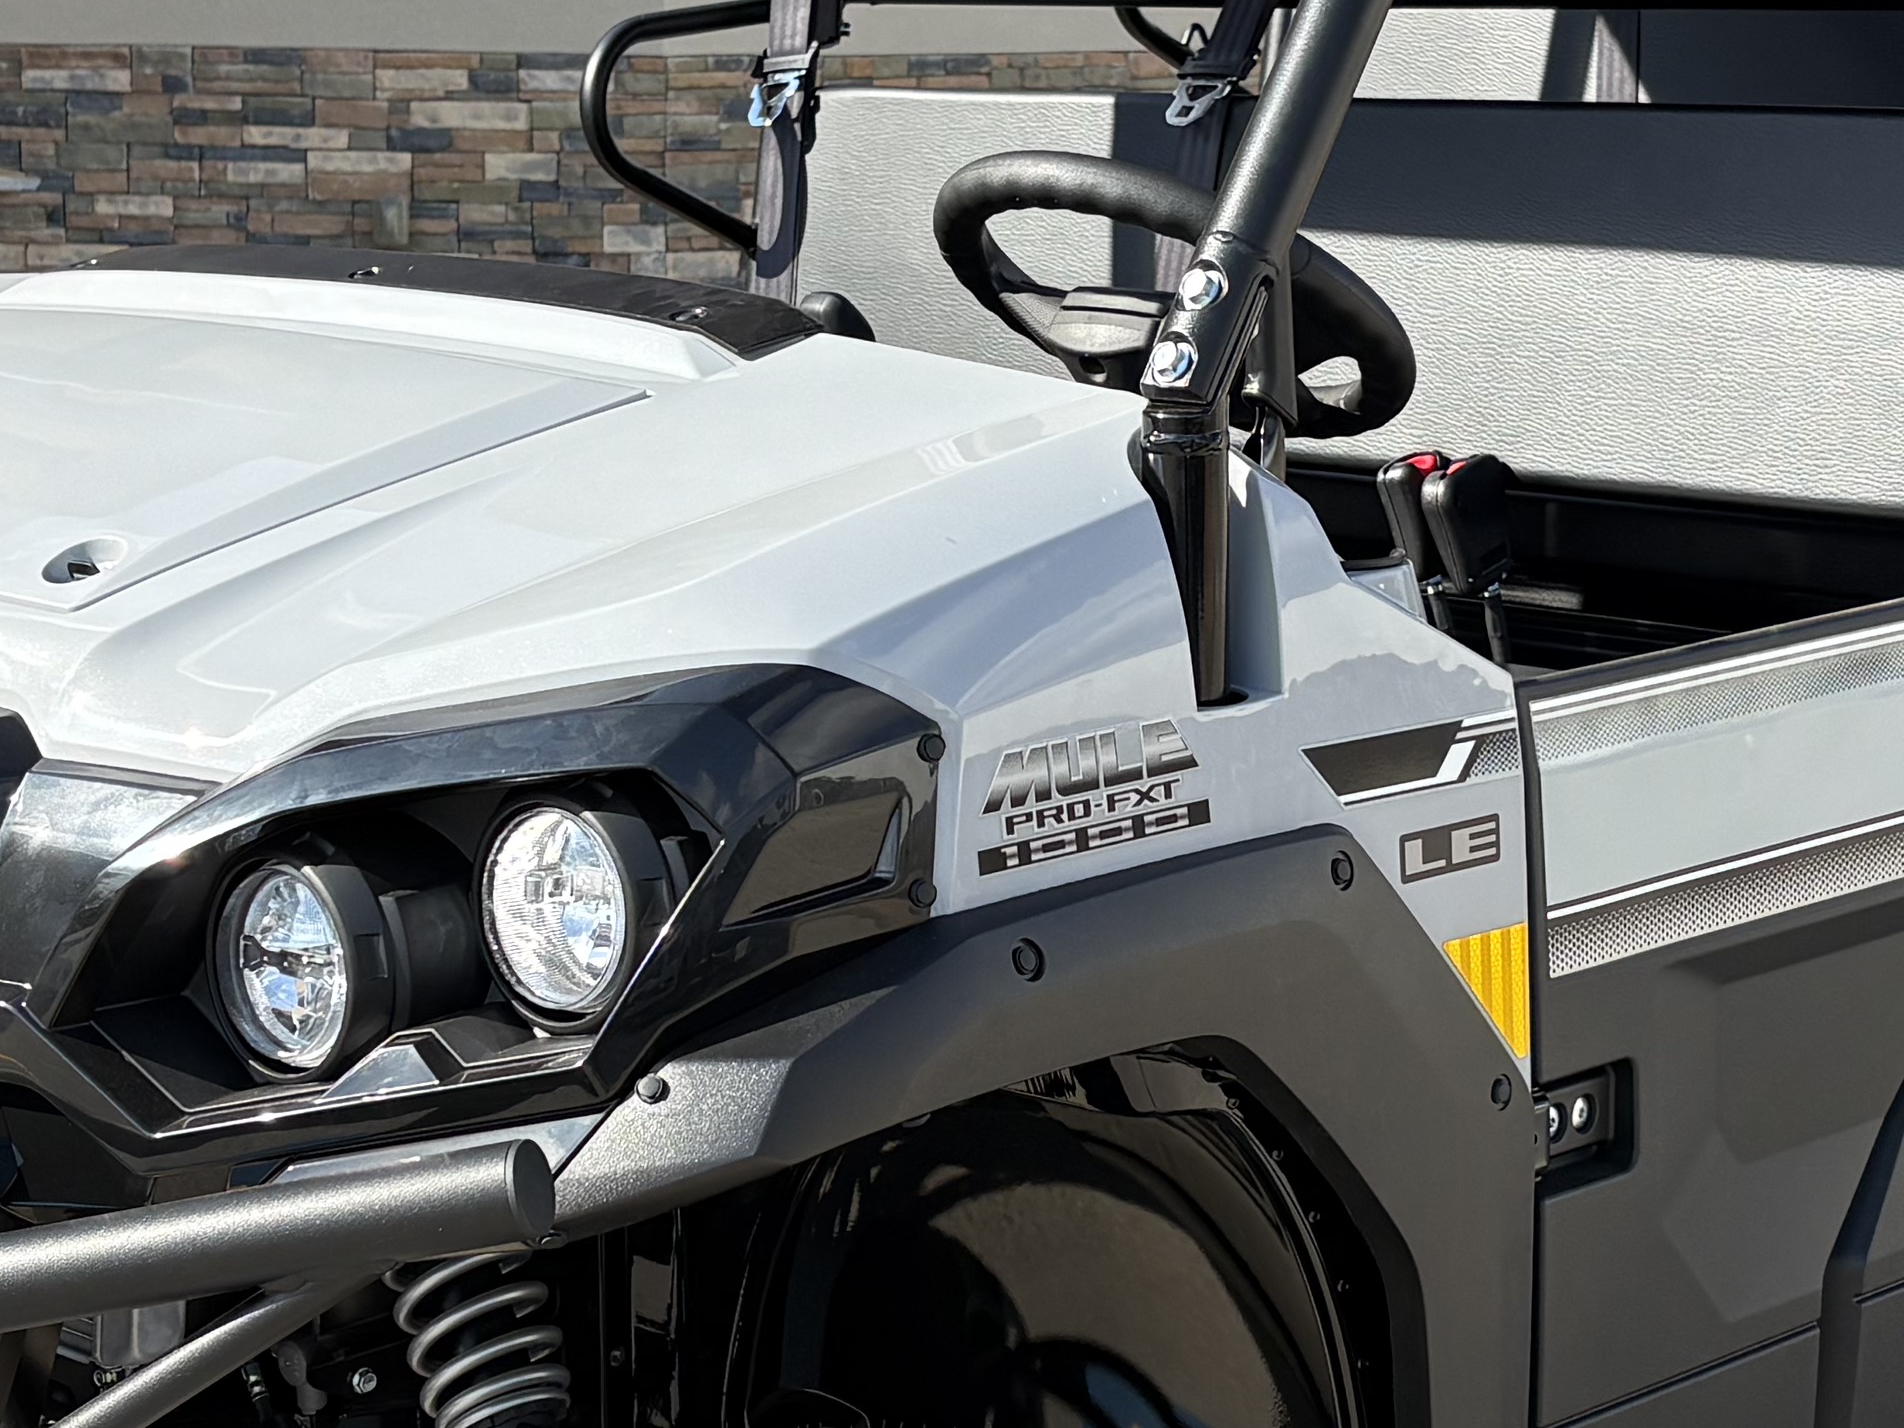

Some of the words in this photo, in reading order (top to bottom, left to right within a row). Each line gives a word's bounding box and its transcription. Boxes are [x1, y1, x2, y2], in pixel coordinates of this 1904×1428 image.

[980, 718, 1201, 818] MULE
[1003, 776, 1182, 837] PRO-FXT
[998, 806, 1188, 870] 1000
[1402, 820, 1498, 878] LE
